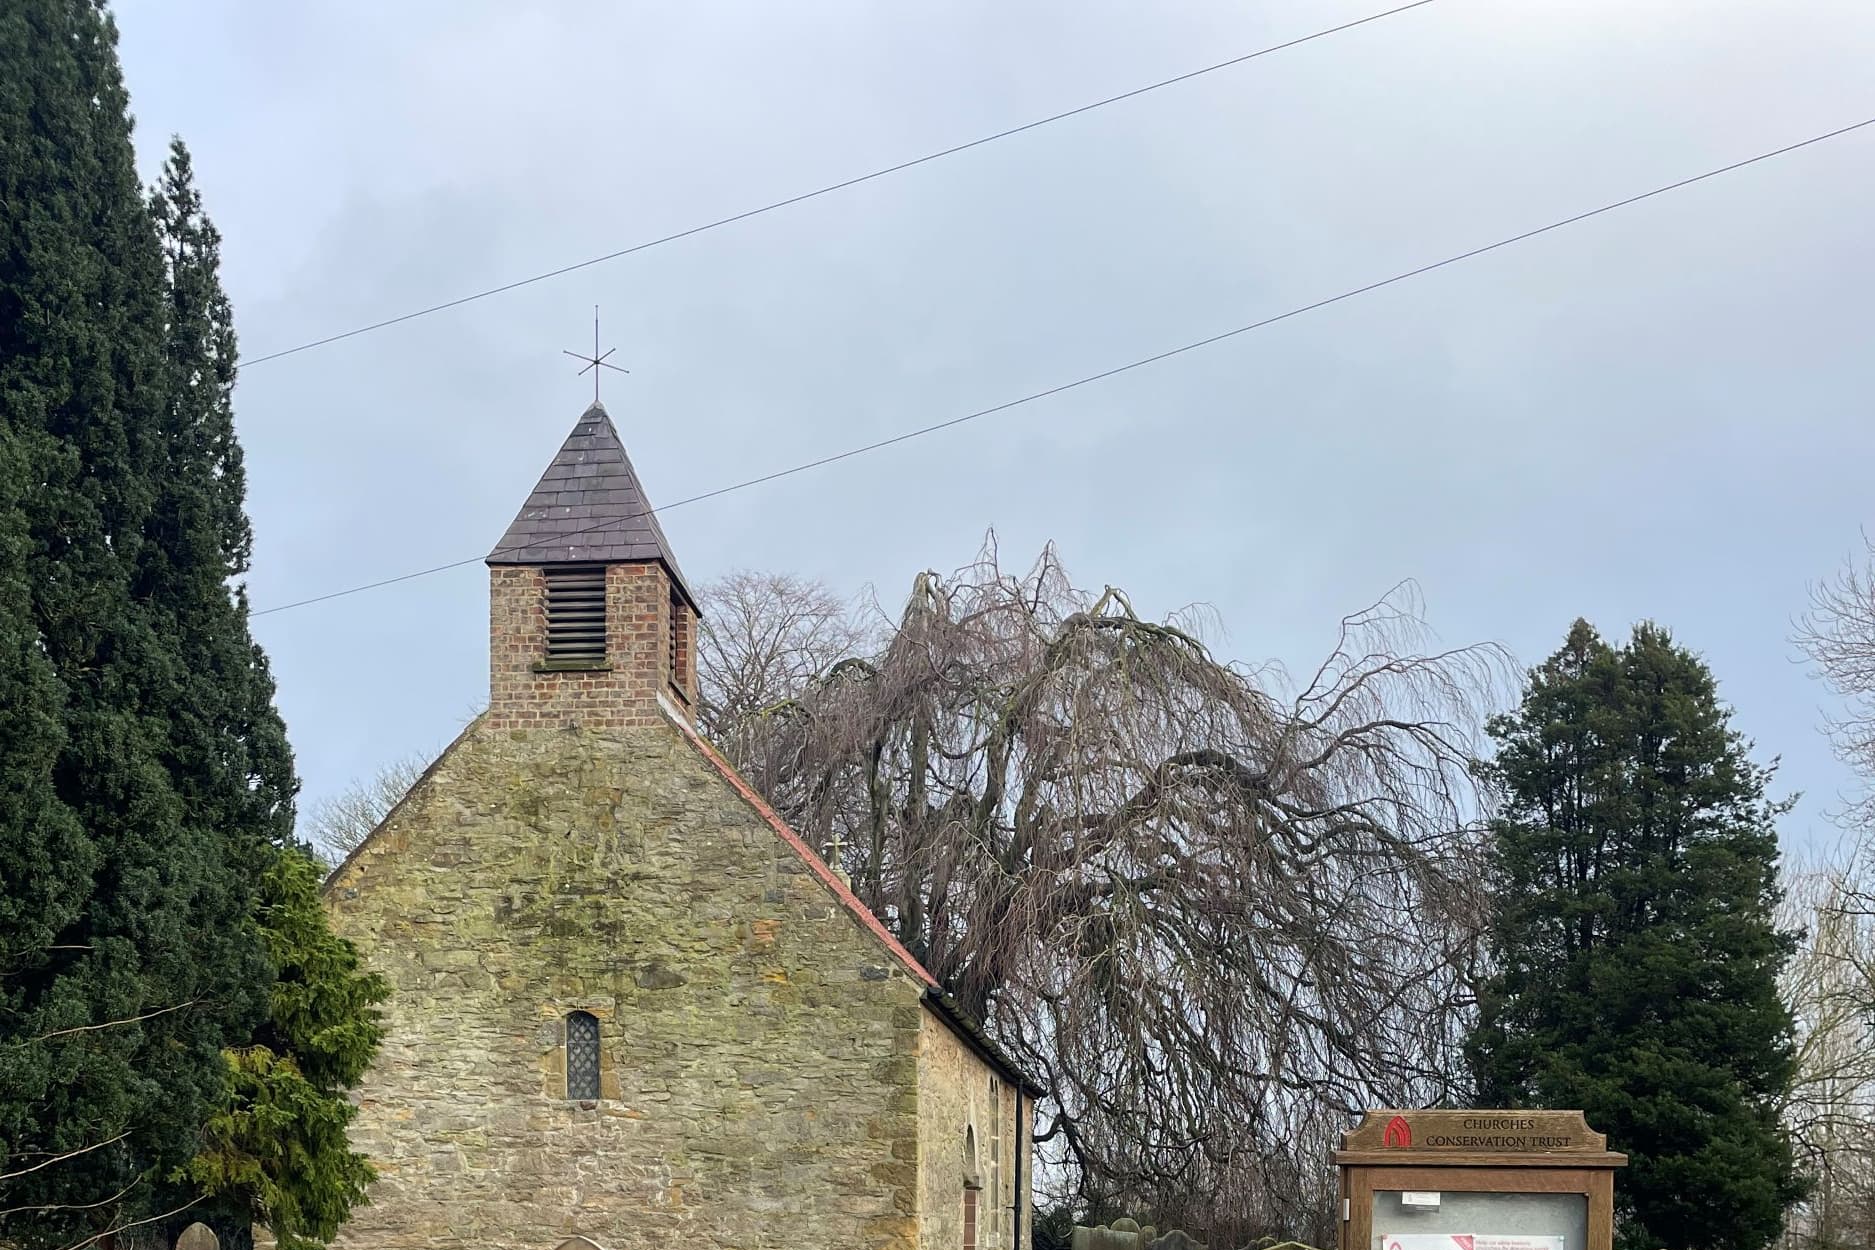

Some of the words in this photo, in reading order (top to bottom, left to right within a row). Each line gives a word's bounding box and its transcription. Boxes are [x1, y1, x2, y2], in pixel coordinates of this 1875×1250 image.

[1463, 1119, 1535, 1130] CHURCHES
[1426, 1135, 1526, 1147] CONSERVATION
[1530, 1136, 1571, 1148] TRUST
